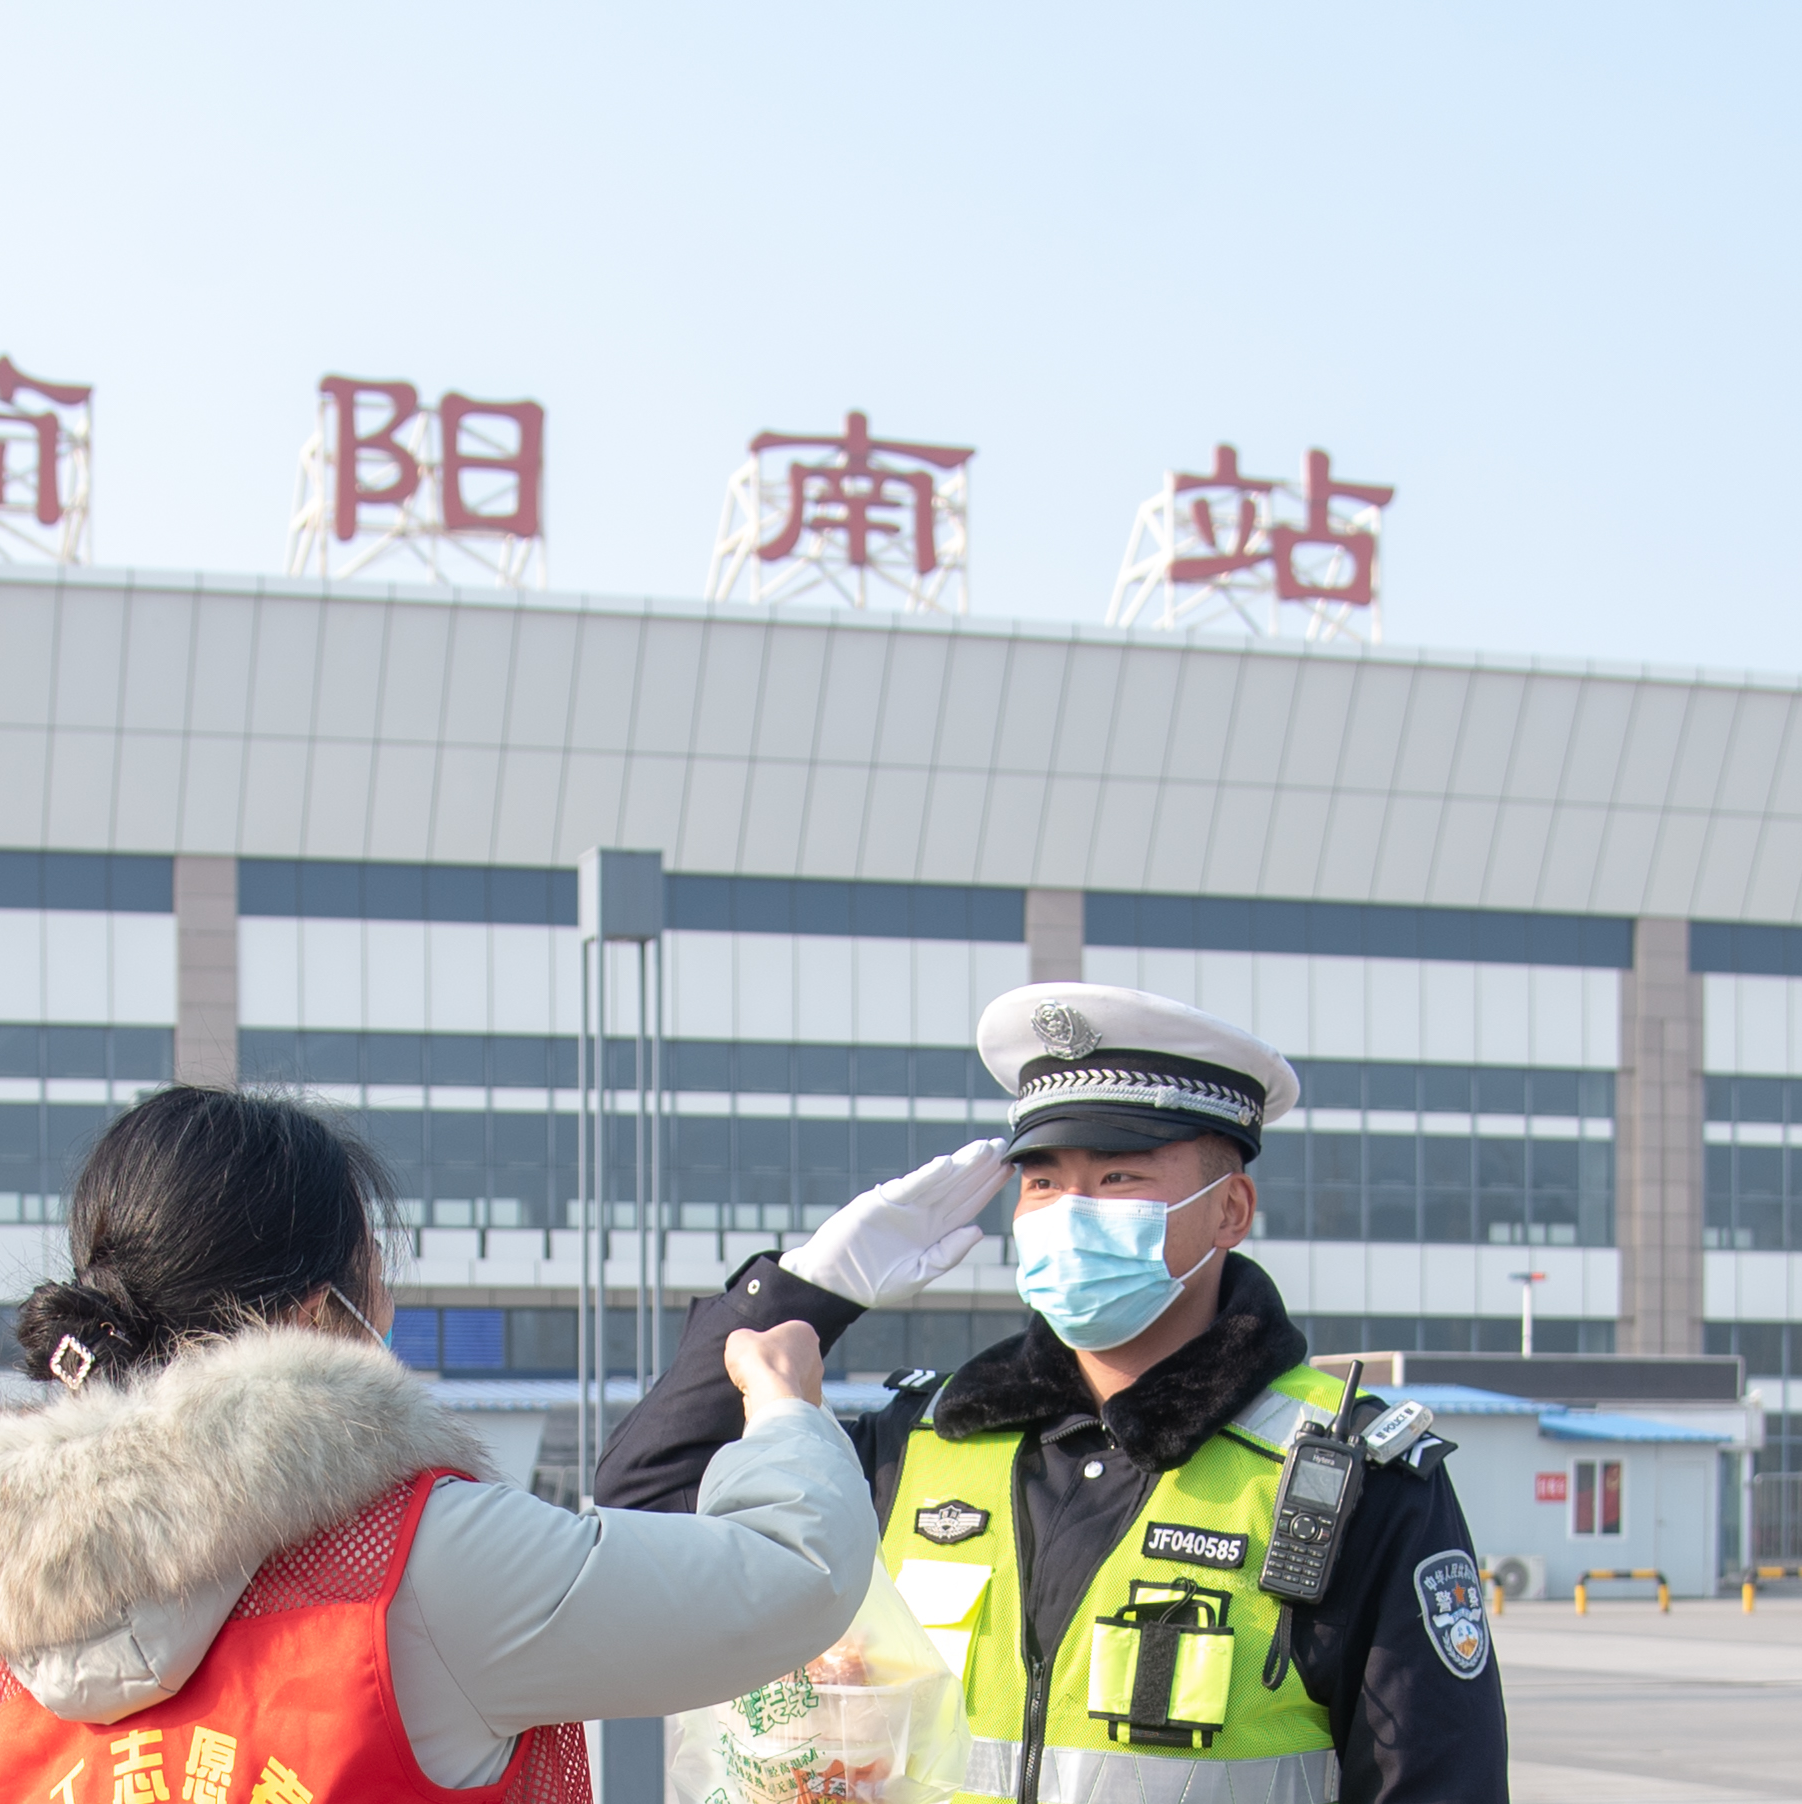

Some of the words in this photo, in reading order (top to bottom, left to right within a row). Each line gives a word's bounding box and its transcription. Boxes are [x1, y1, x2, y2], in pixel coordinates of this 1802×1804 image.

[1382, 1413, 1408, 1433] POLICE
[1312, 1454, 1336, 1467] Hytera
[1147, 1527, 1243, 1562] JF040585
